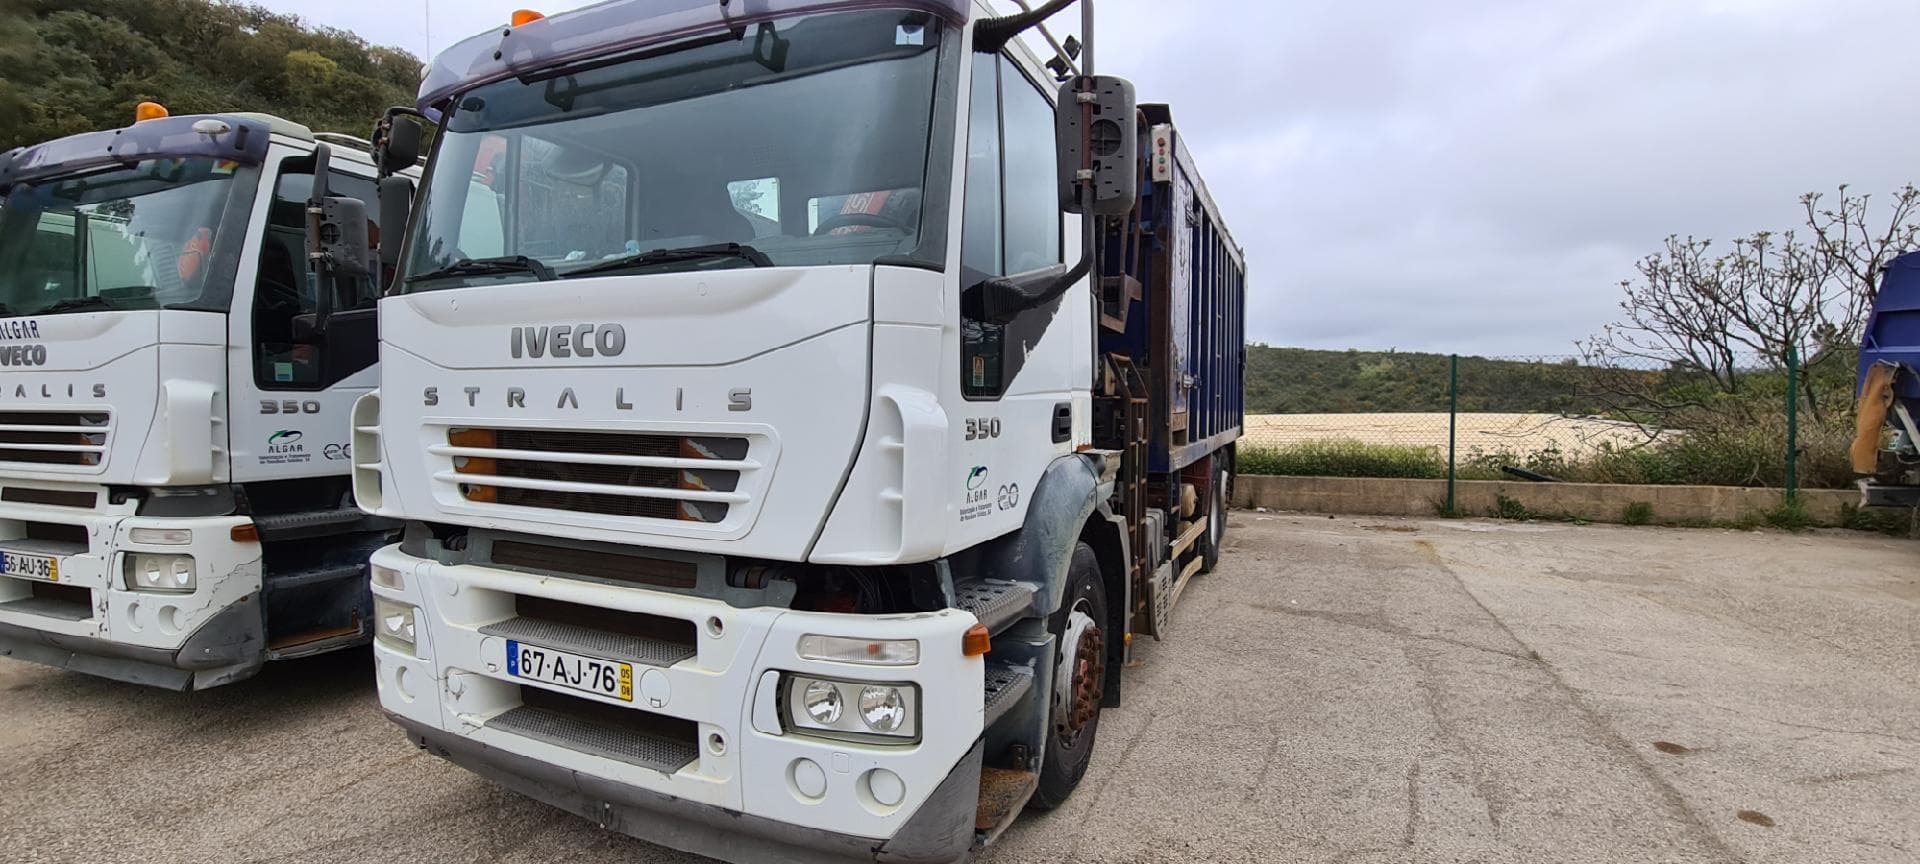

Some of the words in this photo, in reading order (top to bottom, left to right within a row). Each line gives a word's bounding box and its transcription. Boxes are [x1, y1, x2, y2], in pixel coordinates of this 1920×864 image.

[510, 323, 626, 359] IVECO
[0, 383, 106, 398] ALIS
[423, 386, 752, 412] STRALIS
[260, 399, 320, 414] 350
[965, 416, 1002, 441] 350
[268, 444, 303, 454] ALGAR
